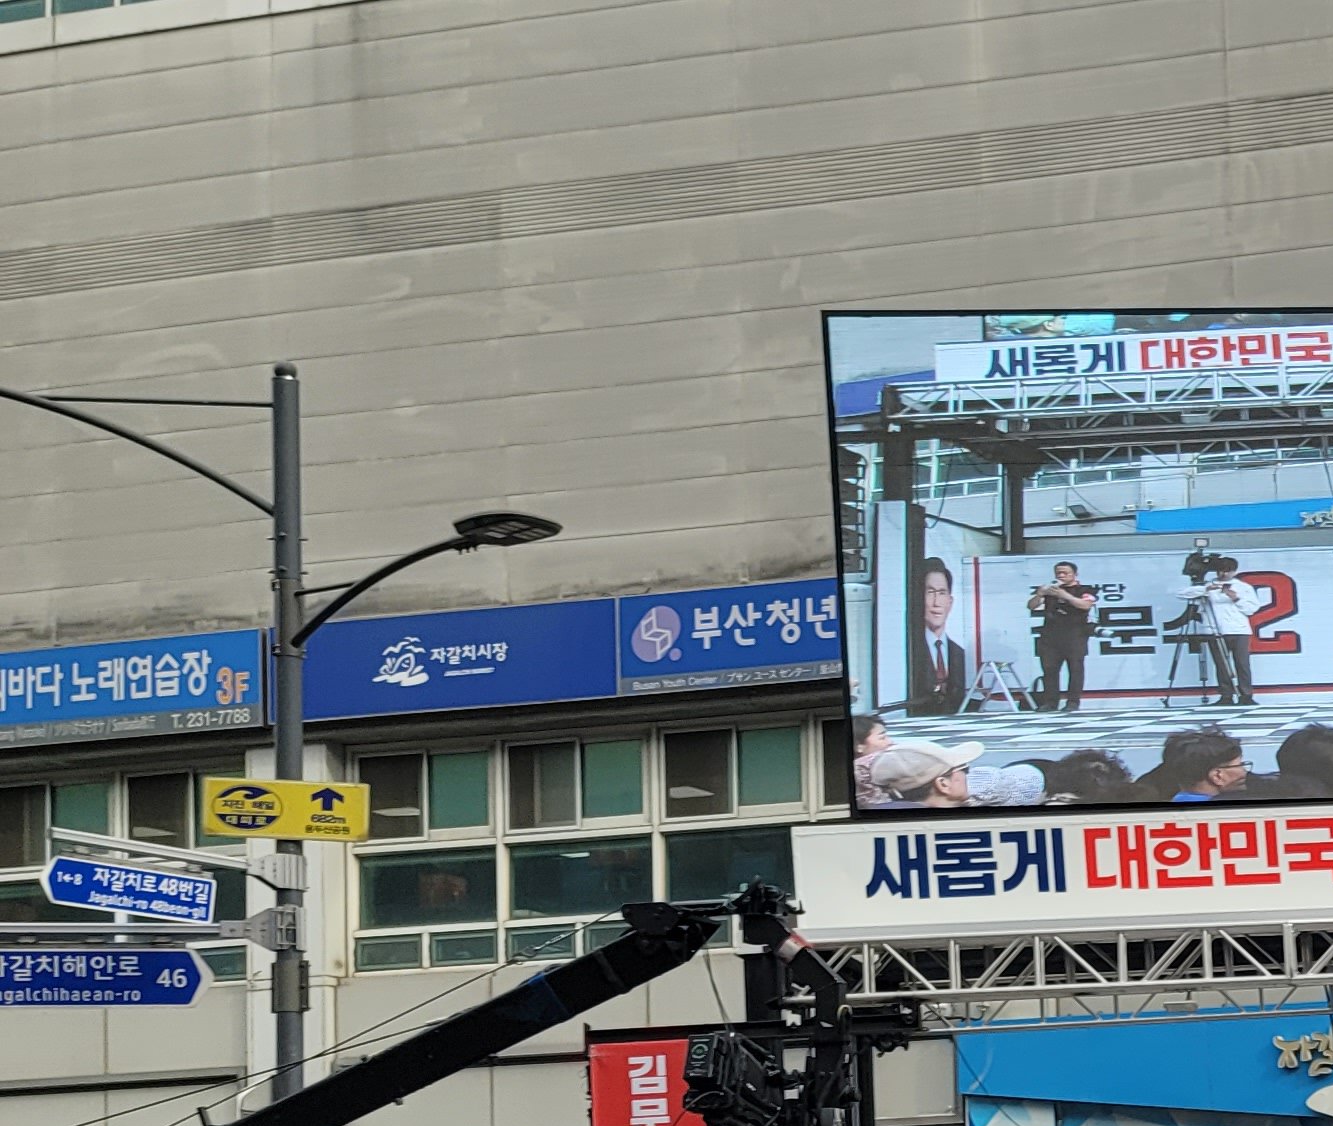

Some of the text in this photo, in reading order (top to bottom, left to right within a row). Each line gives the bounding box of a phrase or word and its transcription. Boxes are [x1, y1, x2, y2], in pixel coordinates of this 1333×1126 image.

[985, 340, 1127, 379] 새롭게
[691, 594, 838, 650] 부산청년
[429, 641, 509, 665] 자갈치시장
[70, 649, 213, 703] 노래연습장
[216, 665, 250, 706] 3F
[864, 827, 1067, 899] 새롭게
[92, 867, 209, 905] 자갈치로48번길
[155, 968, 189, 989] 46
